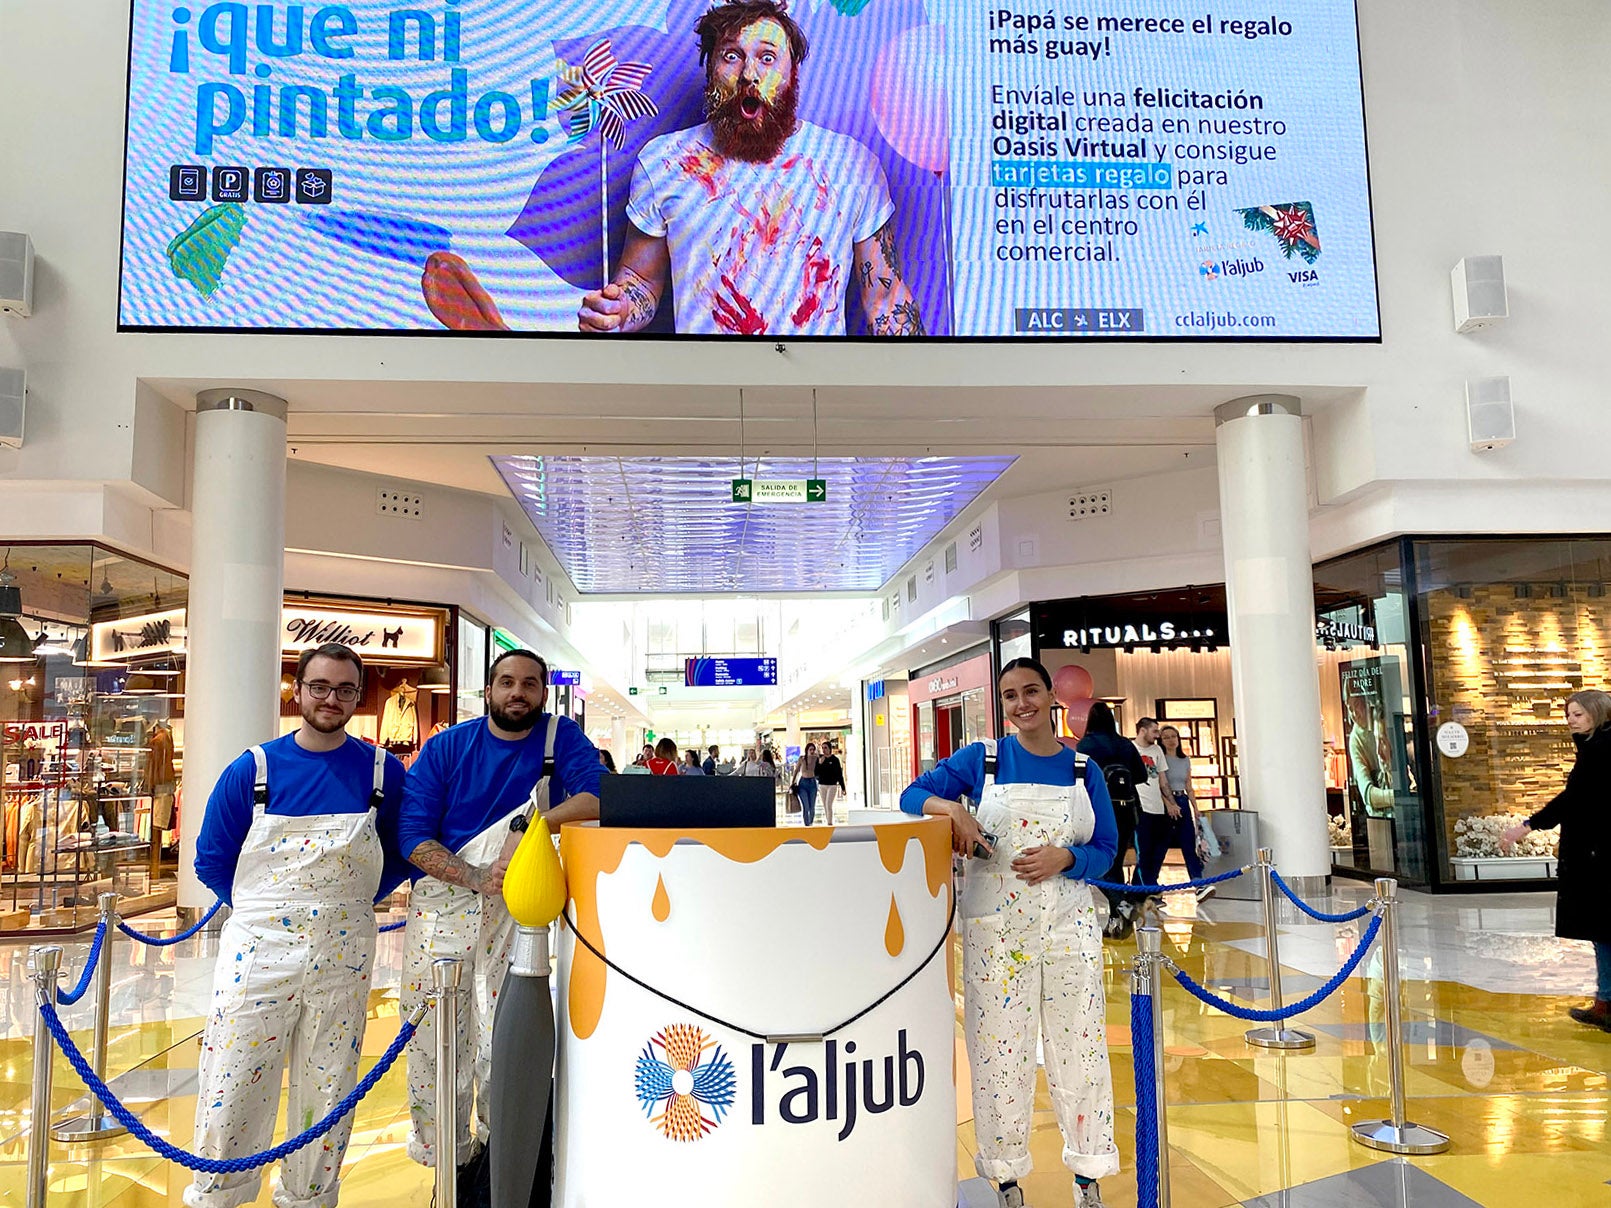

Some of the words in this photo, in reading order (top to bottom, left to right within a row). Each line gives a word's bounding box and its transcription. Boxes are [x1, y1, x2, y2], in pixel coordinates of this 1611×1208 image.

[988, 9, 1056, 34] ¡Papá
[1063, 15, 1089, 31] se
[1097, 16, 1185, 33] merece
[1191, 14, 1212, 34] el
[1220, 15, 1293, 40] regalo
[168, 2, 358, 75] ¡que
[387, 0, 462, 62] ni
[989, 33, 1039, 54] más
[1045, 36, 1111, 60] guay!
[195, 63, 551, 155] pintado!
[991, 84, 1075, 106] Envíale
[1083, 91, 1126, 107] una
[1133, 87, 1264, 110] felicitación
[992, 109, 1067, 135] digital
[1075, 112, 1154, 133] creada
[1161, 117, 1190, 134] en
[1198, 117, 1287, 135] nuestro
[993, 136, 1058, 157] Oasis
[1065, 137, 1147, 158] Virtual
[1153, 143, 1167, 163] y
[1174, 140, 1277, 165] consigue
[992, 162, 1088, 187] tarjetas
[1095, 163, 1170, 189] regalo
[1177, 169, 1228, 190] para
[218, 191, 241, 199] GRATIS
[995, 187, 1130, 210] disfrutarlas
[1137, 194, 1178, 210] con
[1186, 189, 1206, 211] él
[995, 218, 1025, 235] en
[1033, 213, 1053, 235] el
[1061, 216, 1139, 236] centro
[996, 240, 1120, 262] comercial.
[1221, 257, 1264, 278] l'aljub
[1287, 270, 1319, 283] VISA
[1027, 311, 1063, 328] ALC
[1098, 311, 1131, 328] ELX
[1175, 311, 1276, 331] cclaljub.com
[286, 618, 374, 646] Williot
[1341, 669, 1357, 680] FELIZ
[1371, 666, 1384, 677] DEL
[1353, 678, 1373, 688] PADRE
[2, 724, 62, 745] SALE
[751, 1028, 926, 1142] l'aljub
